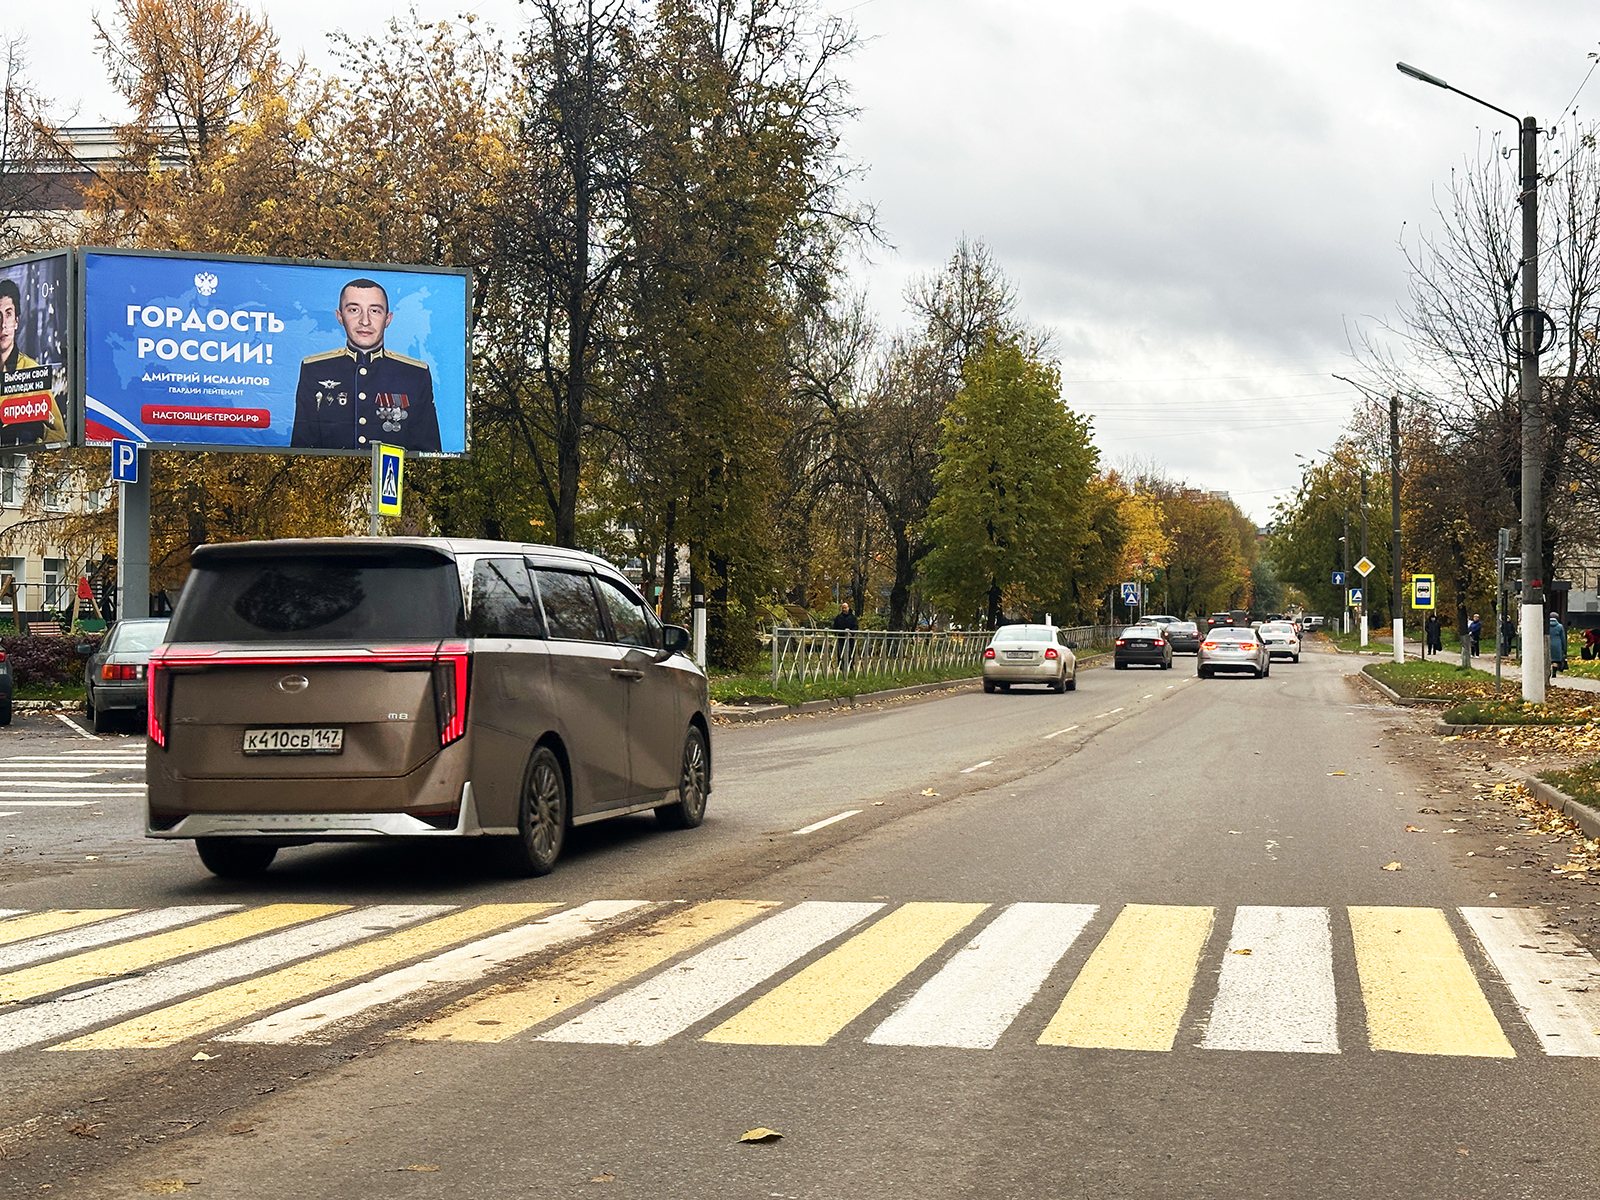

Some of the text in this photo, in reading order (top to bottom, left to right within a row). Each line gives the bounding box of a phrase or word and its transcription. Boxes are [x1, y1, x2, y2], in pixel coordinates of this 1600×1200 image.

[42, 282, 55, 298] 0+
[127, 305, 285, 333] ГОРДОСТЬ
[137, 337, 273, 365] РОССИИ!
[4, 366, 49, 383] Выбери свой
[141, 372, 270, 386] ДМИТРИЙ ИСМАИЛОВ
[4, 380, 44, 394] колледж на
[168, 386, 244, 396] ГВАРДИИ ЛЕЙТЕНАНТ
[4, 399, 49, 419] япроф.рф
[152, 410, 260, 423] НАСТОЯЩИЕ-ГЕРОИ.РФ
[119, 444, 134, 478] P
[314, 730, 339, 744] 147
